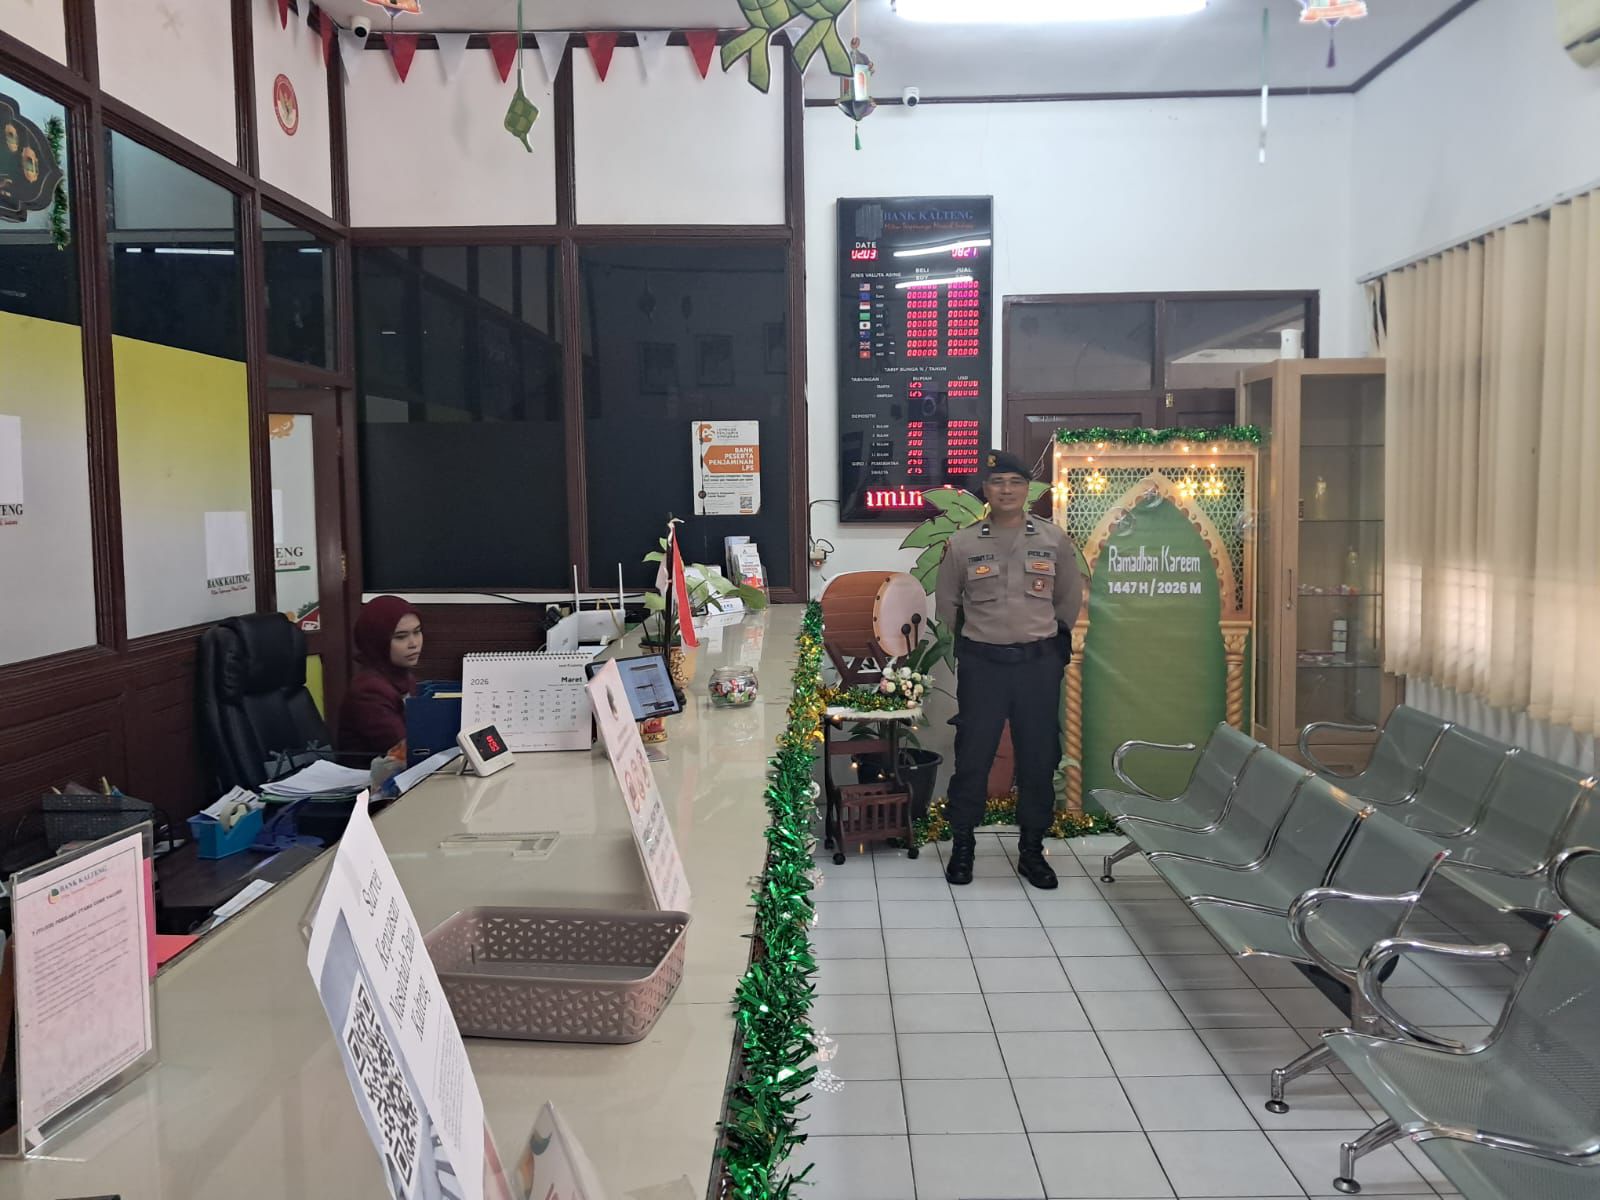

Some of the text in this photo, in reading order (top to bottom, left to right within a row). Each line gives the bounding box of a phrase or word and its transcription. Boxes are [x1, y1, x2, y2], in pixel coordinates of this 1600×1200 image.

[918, 209, 974, 221] KALTENG
[855, 241, 877, 249] DATE
[0, 503, 23, 516] ENG
[1108, 545, 1201, 572] Ramadhan Kareem
[207, 574, 251, 589] BANK KALTENG
[1108, 578, 1201, 597] 1447 H / 2026 M
[470, 678, 489, 686] 2026
[375, 896, 400, 972] Kepuasan
[389, 951, 411, 1029] Nasabah
[410, 975, 431, 1042] Kalteng
